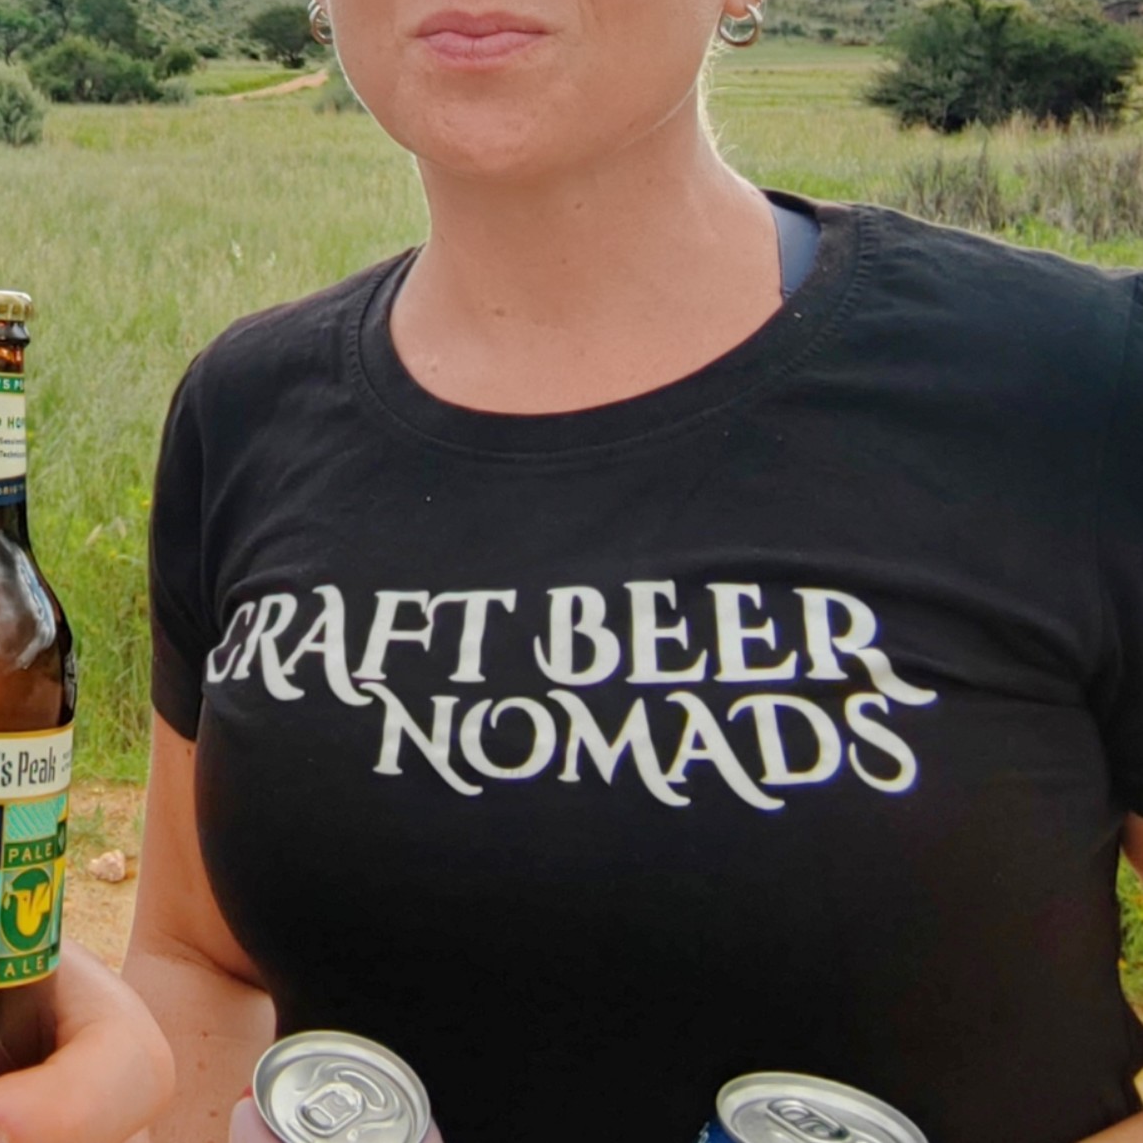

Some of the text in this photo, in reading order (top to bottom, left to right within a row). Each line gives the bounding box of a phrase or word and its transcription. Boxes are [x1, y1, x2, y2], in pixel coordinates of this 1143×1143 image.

[207, 580, 938, 706] CRAFT BEER
[359, 681, 918, 810] NOMADS
[17, 747, 56, 787] Peak
[8, 842, 53, 863] PALE
[4, 955, 45, 977] ALE
